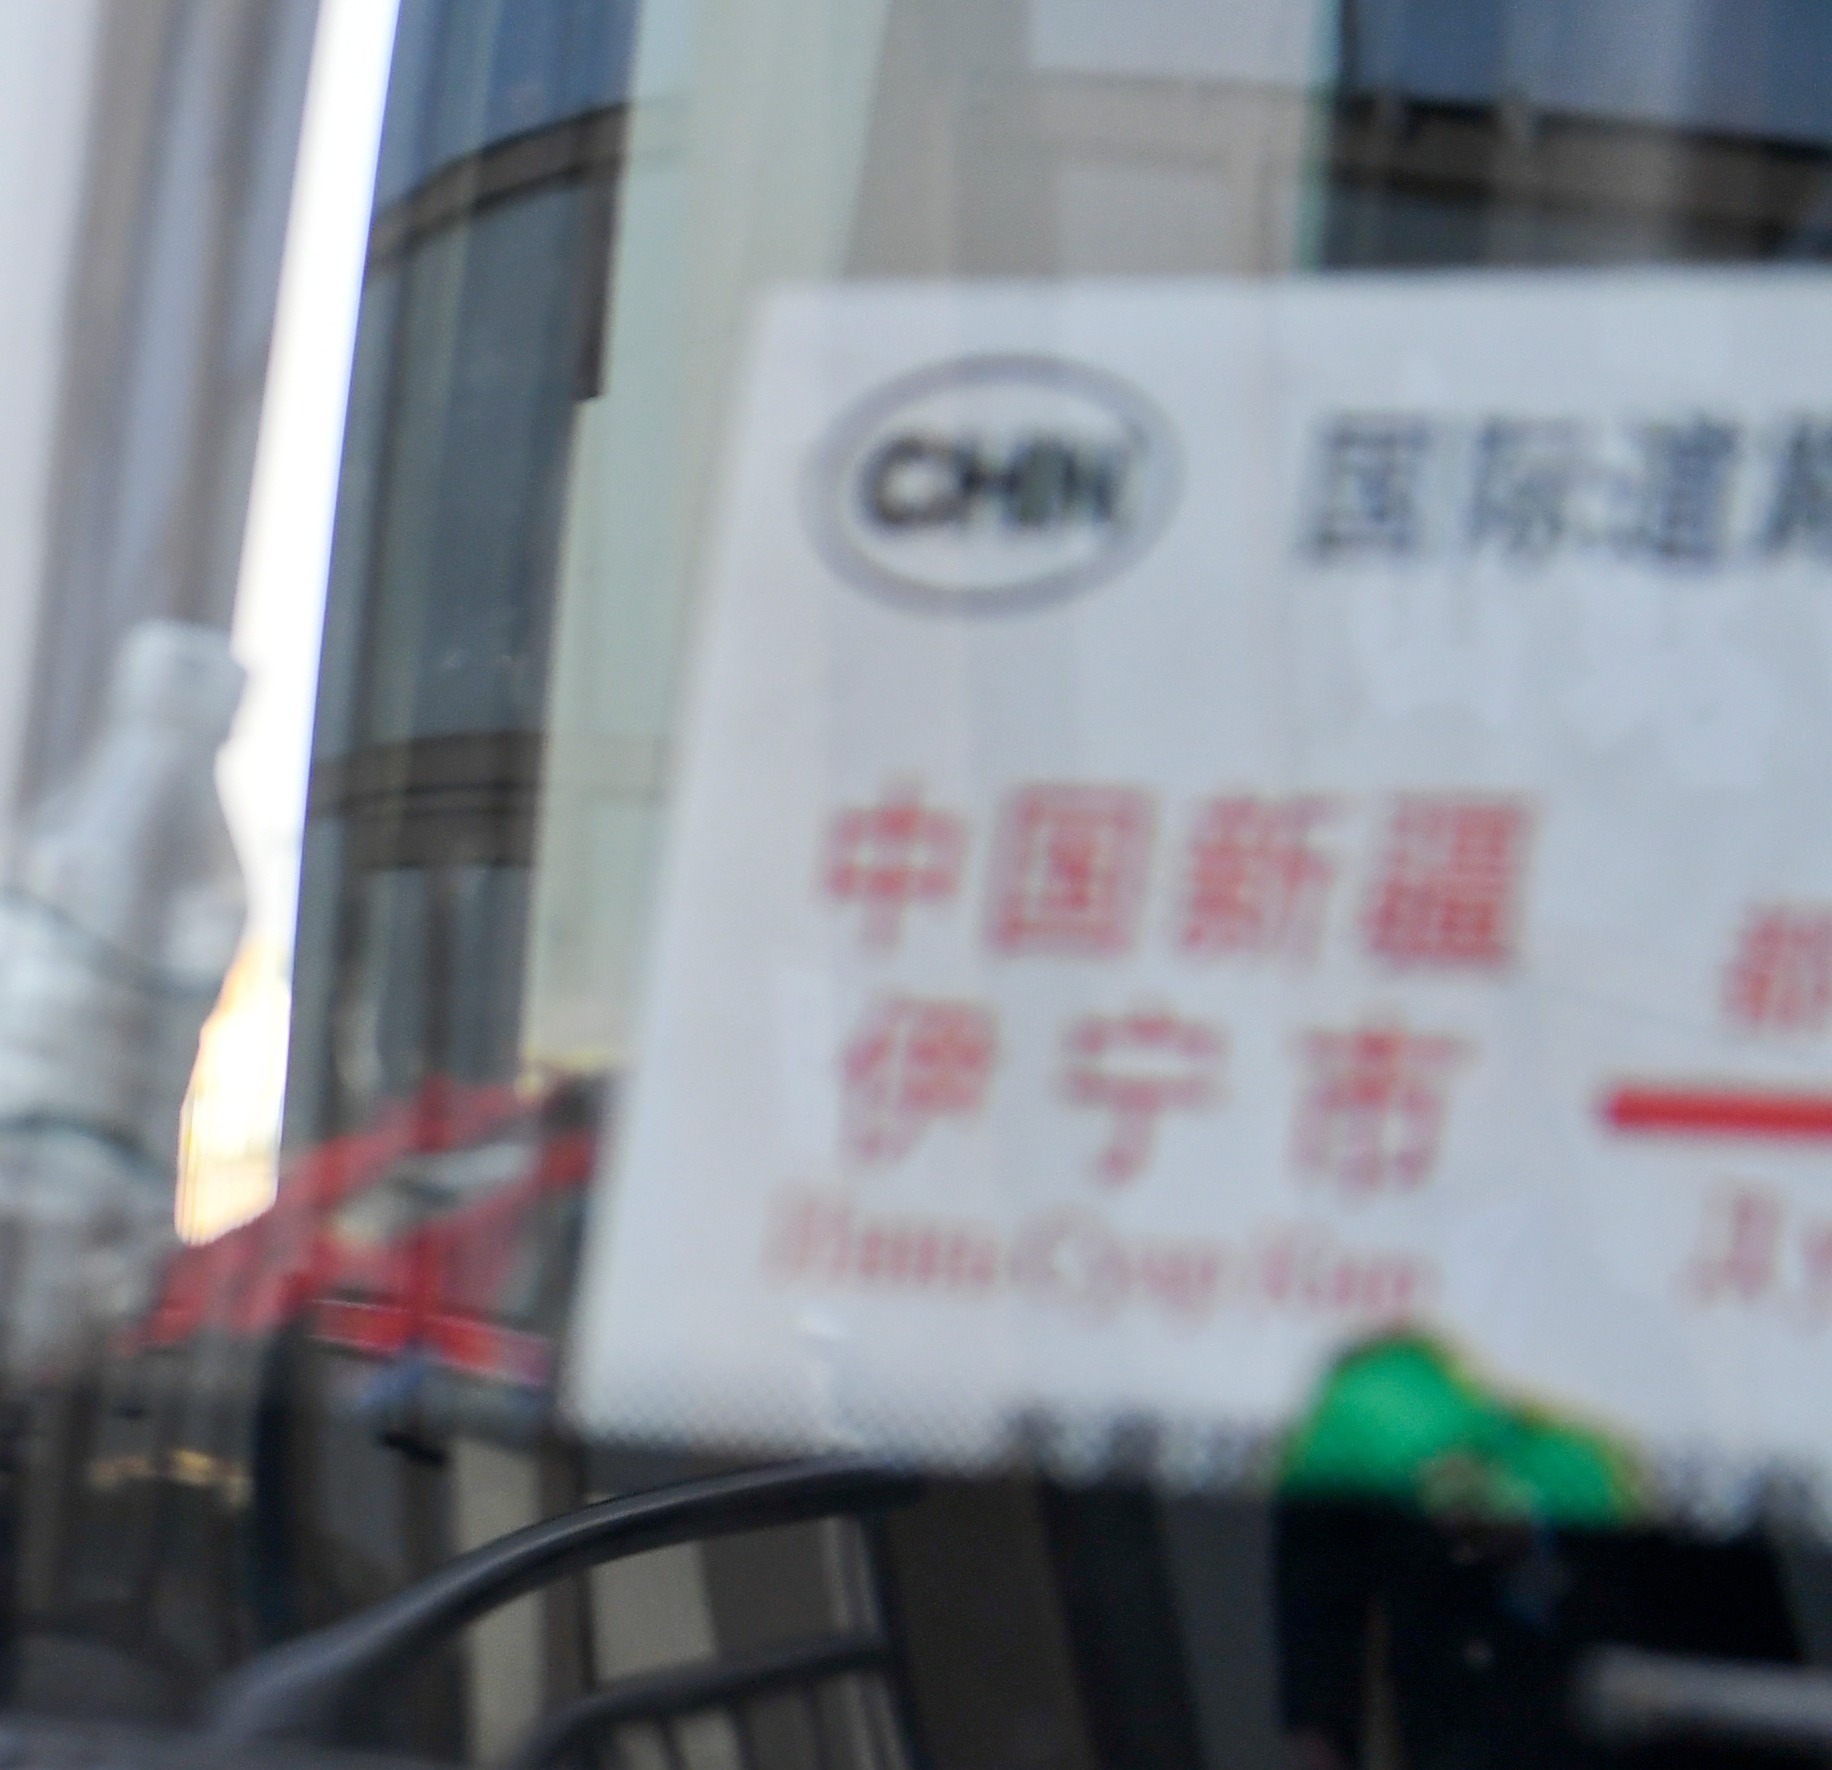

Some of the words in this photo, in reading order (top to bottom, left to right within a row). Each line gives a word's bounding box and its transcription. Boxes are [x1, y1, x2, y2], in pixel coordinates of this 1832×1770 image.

[859, 433, 1126, 534] CHN
[826, 786, 1528, 970] 中国新疆
[844, 1002, 1466, 1186] 伊宁市
